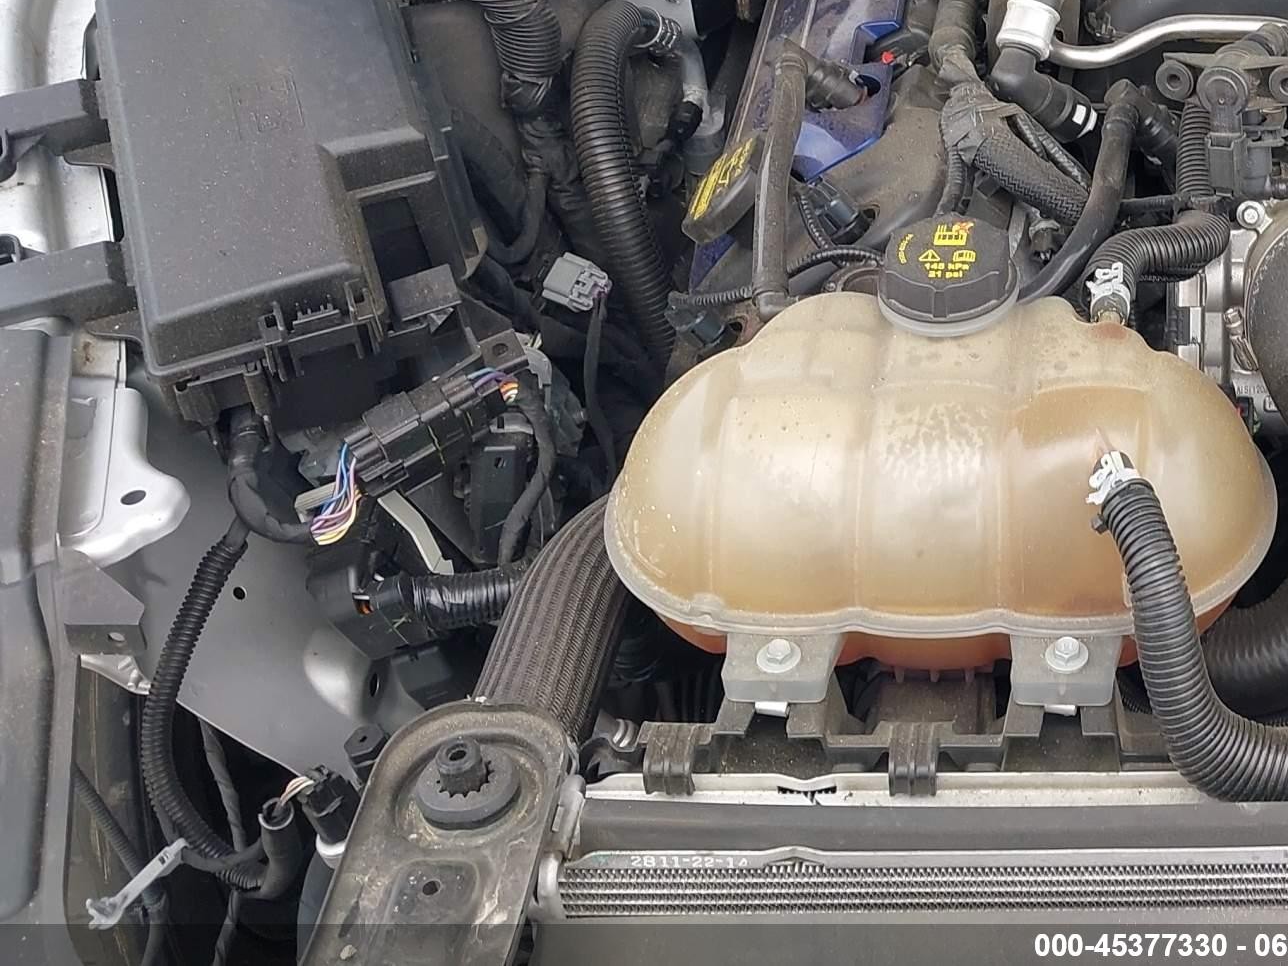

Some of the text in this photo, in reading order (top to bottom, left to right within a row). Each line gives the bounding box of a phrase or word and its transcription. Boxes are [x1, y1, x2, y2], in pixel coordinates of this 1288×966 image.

[947, 262, 970, 271] kPa
[927, 270, 963, 279] 21 psi
